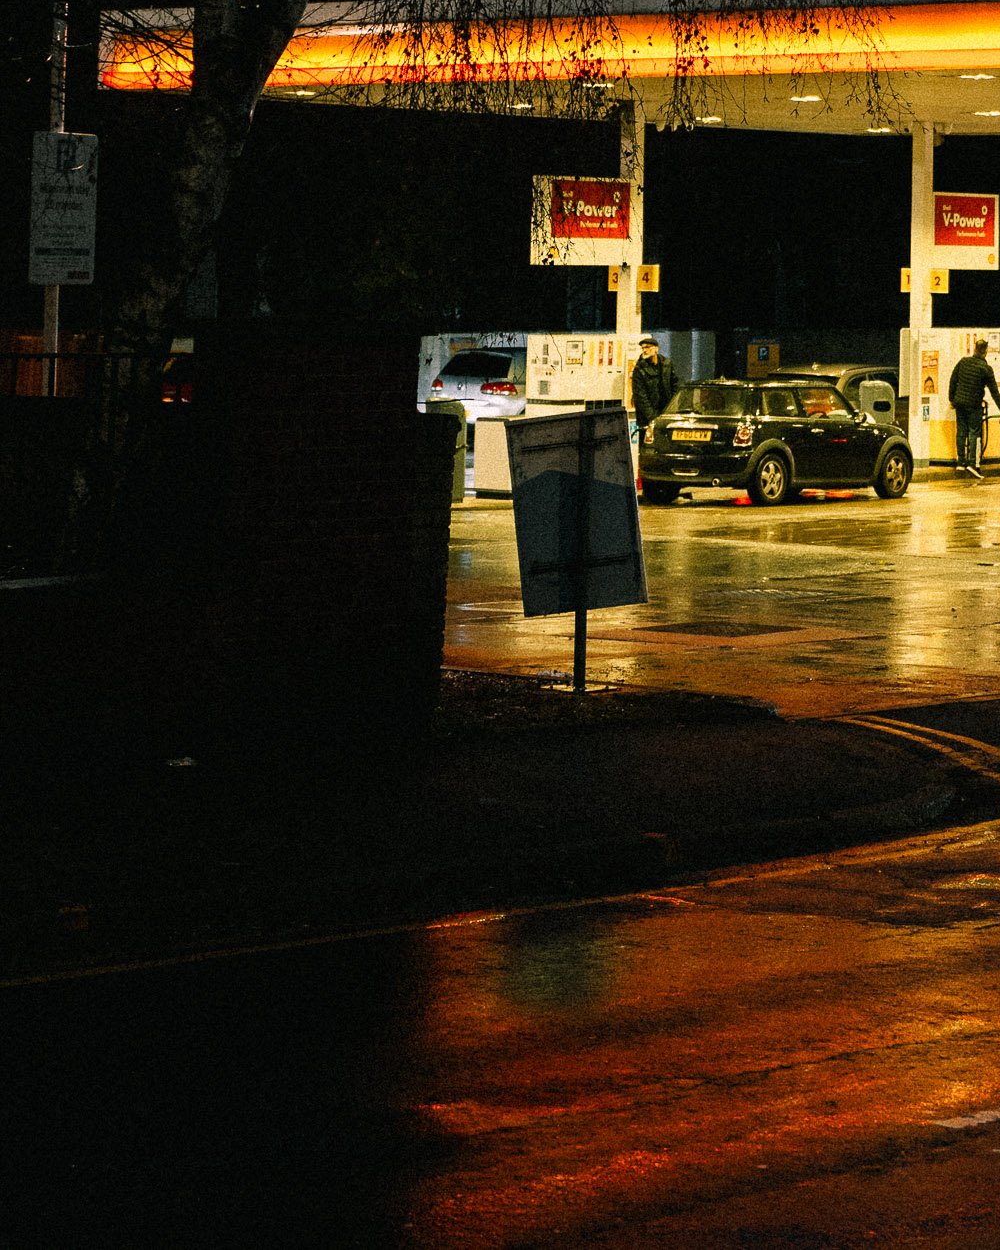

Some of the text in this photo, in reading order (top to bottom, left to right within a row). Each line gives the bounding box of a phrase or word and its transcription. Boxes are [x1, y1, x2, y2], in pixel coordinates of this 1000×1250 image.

[563, 200, 617, 217] V-Power
[943, 213, 985, 227] V-Power
[612, 272, 619, 284] 3
[641, 272, 650, 284] 4
[934, 276, 941, 286] 2
